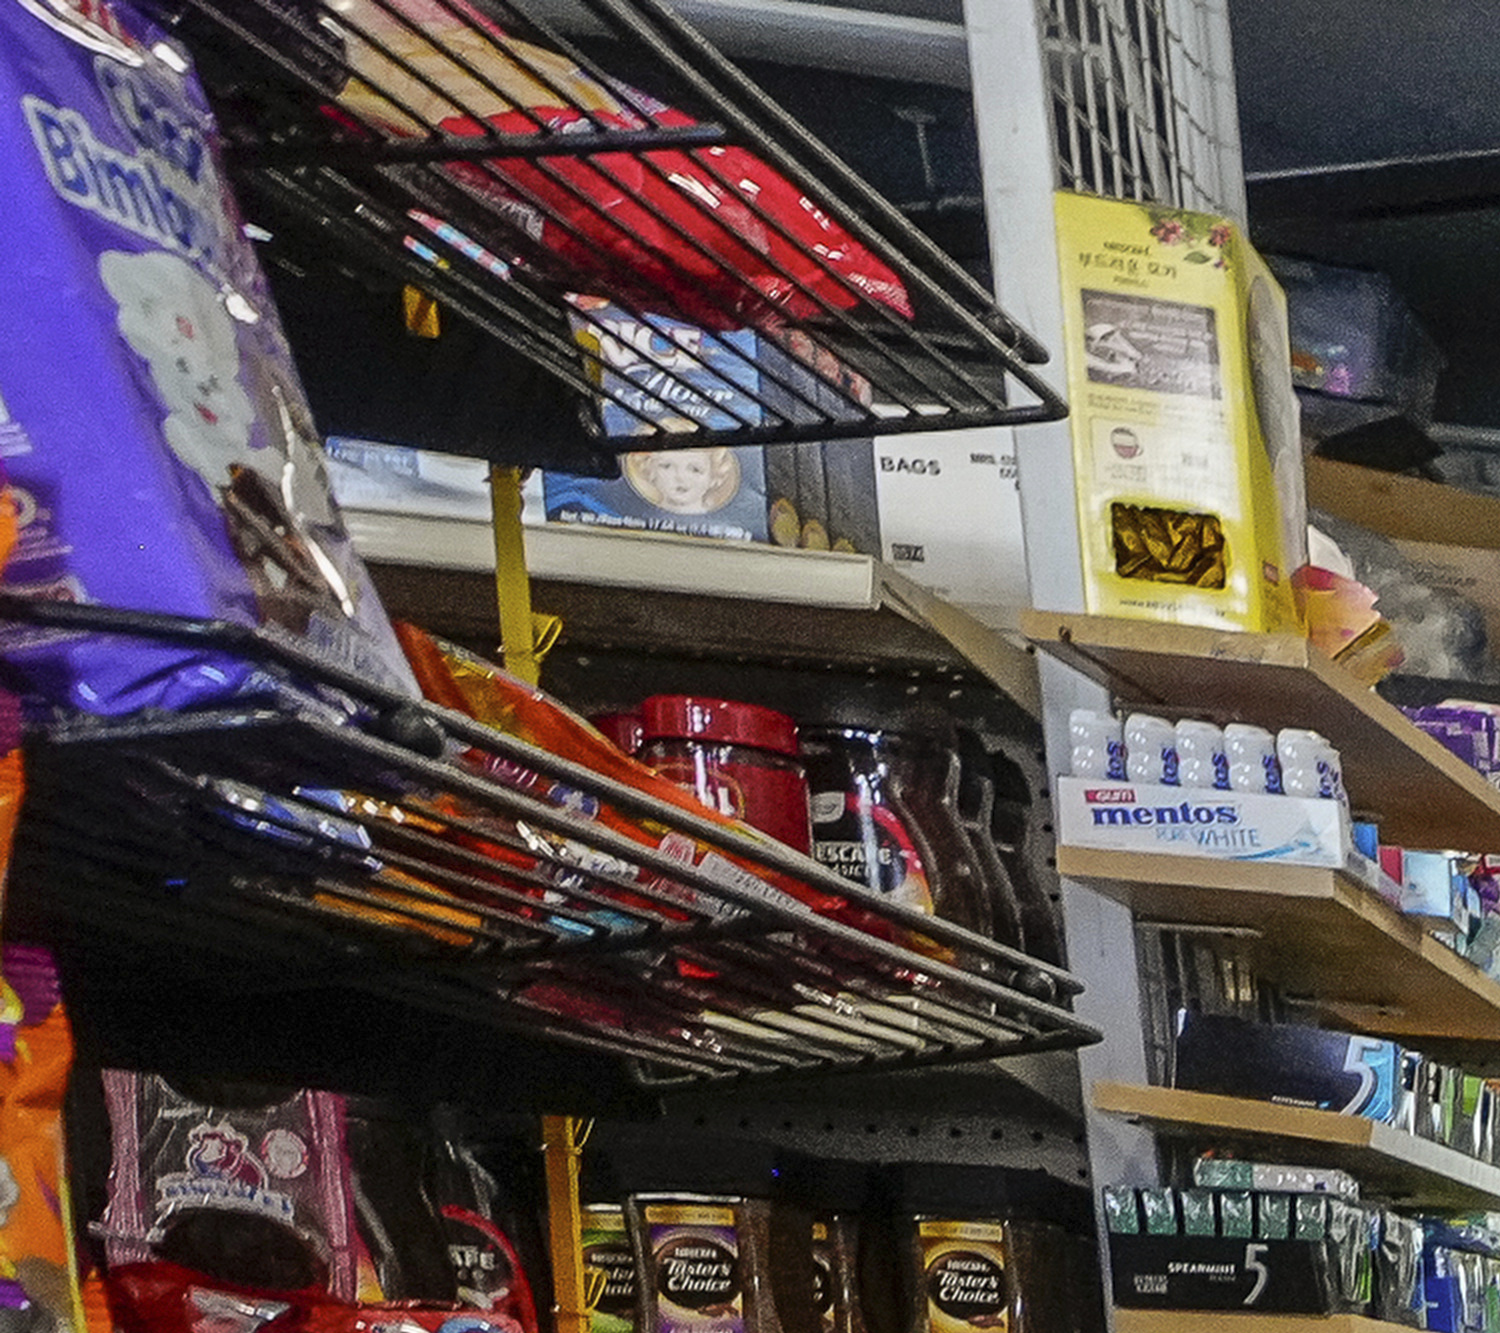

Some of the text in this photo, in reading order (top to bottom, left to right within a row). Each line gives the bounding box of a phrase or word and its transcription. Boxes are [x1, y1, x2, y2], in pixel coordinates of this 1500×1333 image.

[880, 454, 941, 477] BAGS
[1092, 801, 1239, 826] mentos
[1196, 827, 1260, 850] WHITE
[667, 1275, 731, 1293] Choice
[1243, 1244, 1270, 1305] 5
[940, 1285, 999, 1303] Choice
